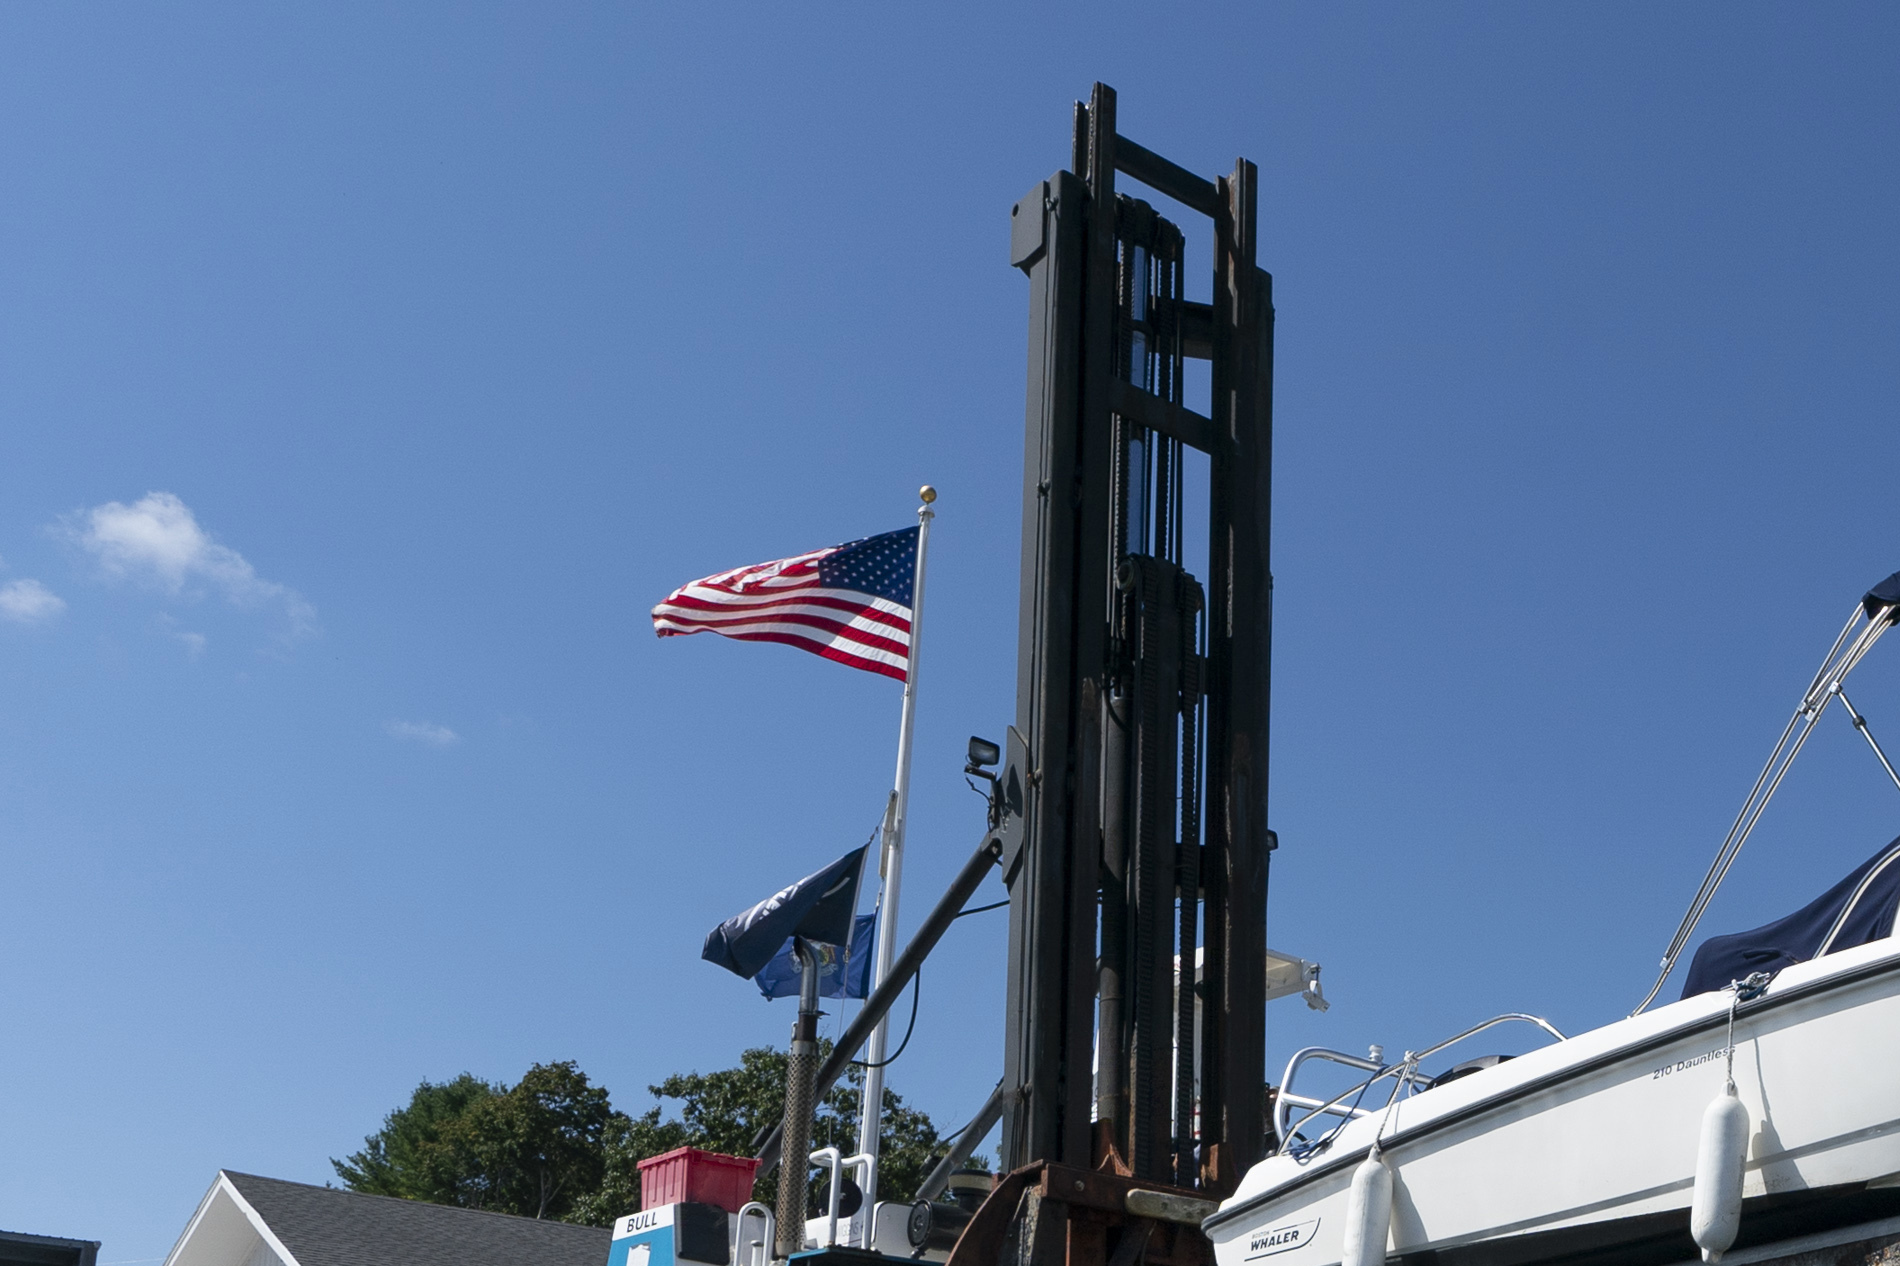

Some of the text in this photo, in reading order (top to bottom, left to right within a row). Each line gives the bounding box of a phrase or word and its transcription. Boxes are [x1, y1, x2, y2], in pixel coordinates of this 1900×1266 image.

[1653, 1065, 1672, 1080] 210
[627, 1211, 658, 1233] BULL
[1251, 1230, 1300, 1251] WHALER
